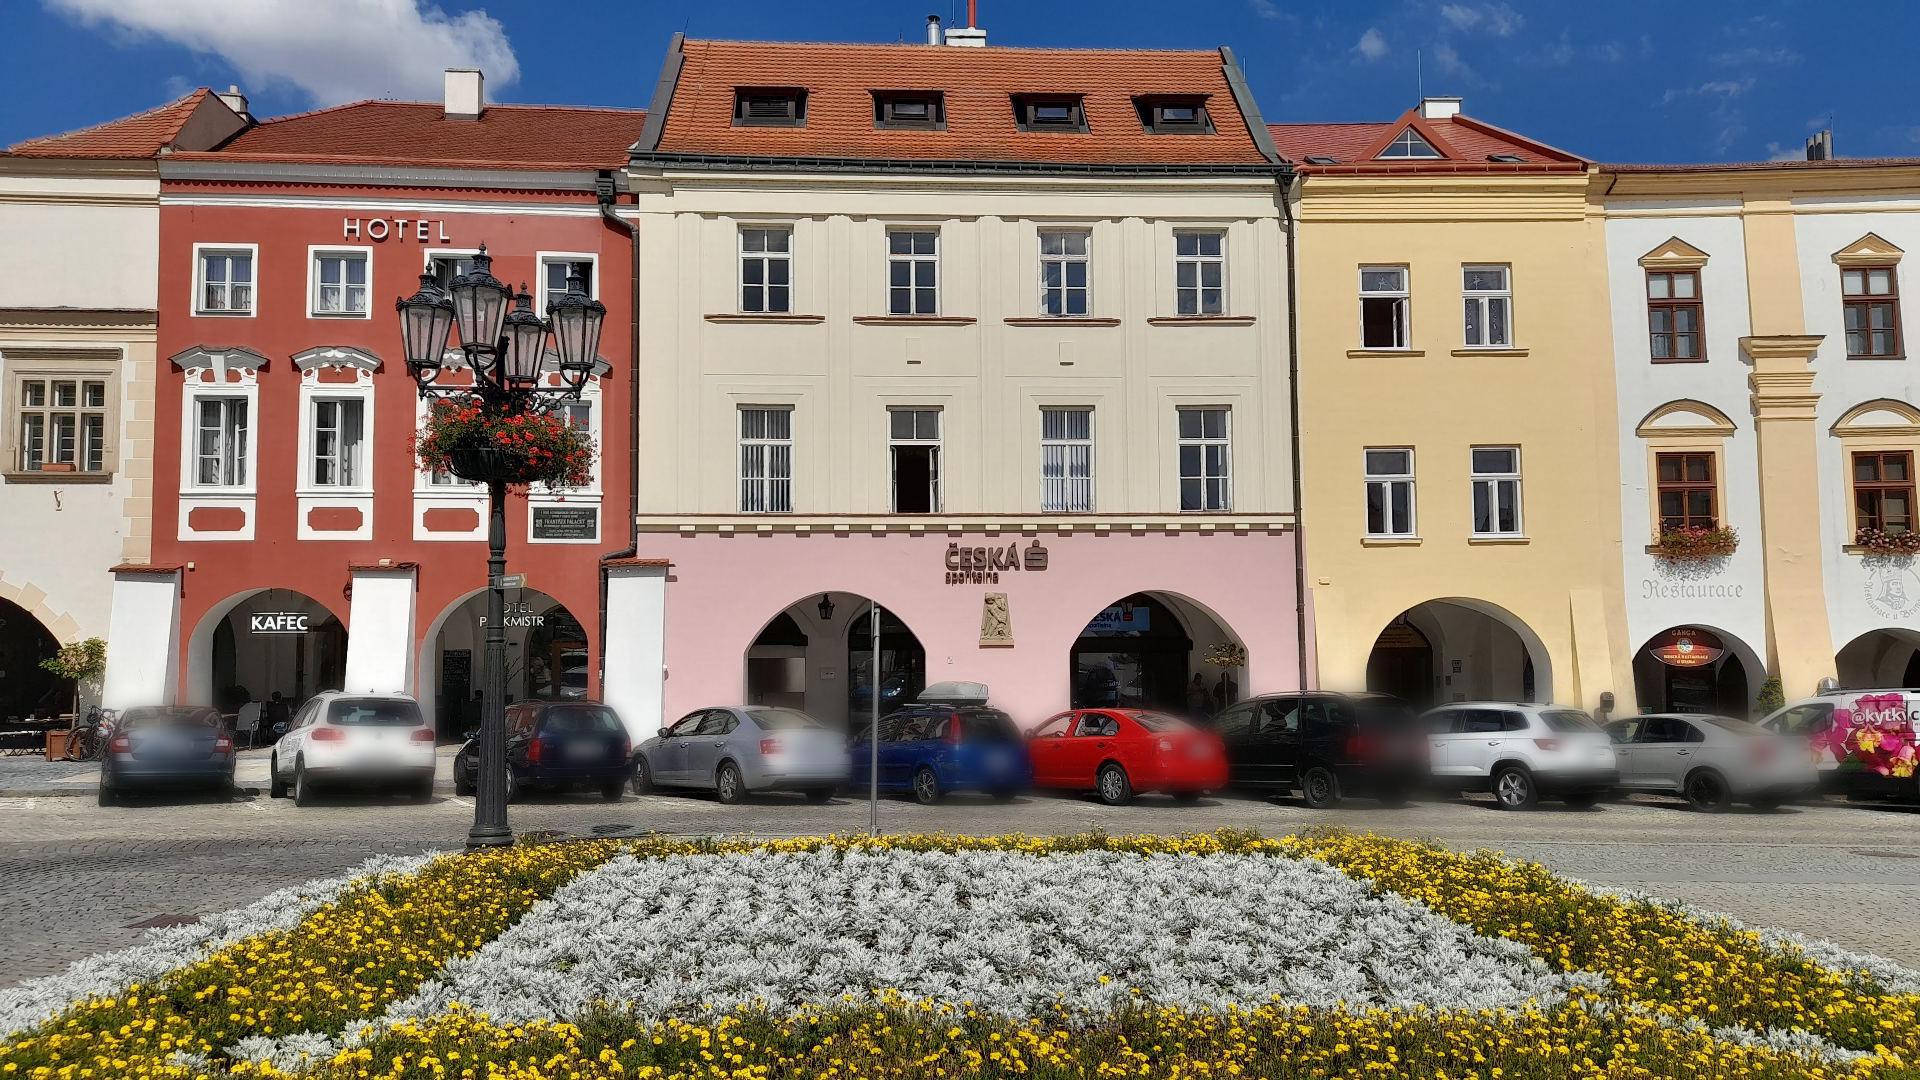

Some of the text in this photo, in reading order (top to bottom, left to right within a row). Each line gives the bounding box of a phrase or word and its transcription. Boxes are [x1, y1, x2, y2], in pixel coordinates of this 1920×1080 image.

[343, 217, 450, 240] HOTEL
[944, 541, 1021, 571] ČESKÁ
[945, 570, 999, 586] spořitelna
[1642, 579, 1744, 599] Restaurace
[503, 602, 534, 613] OTEL
[251, 615, 309, 630] KAFEC
[479, 615, 545, 627] PKMISTR
